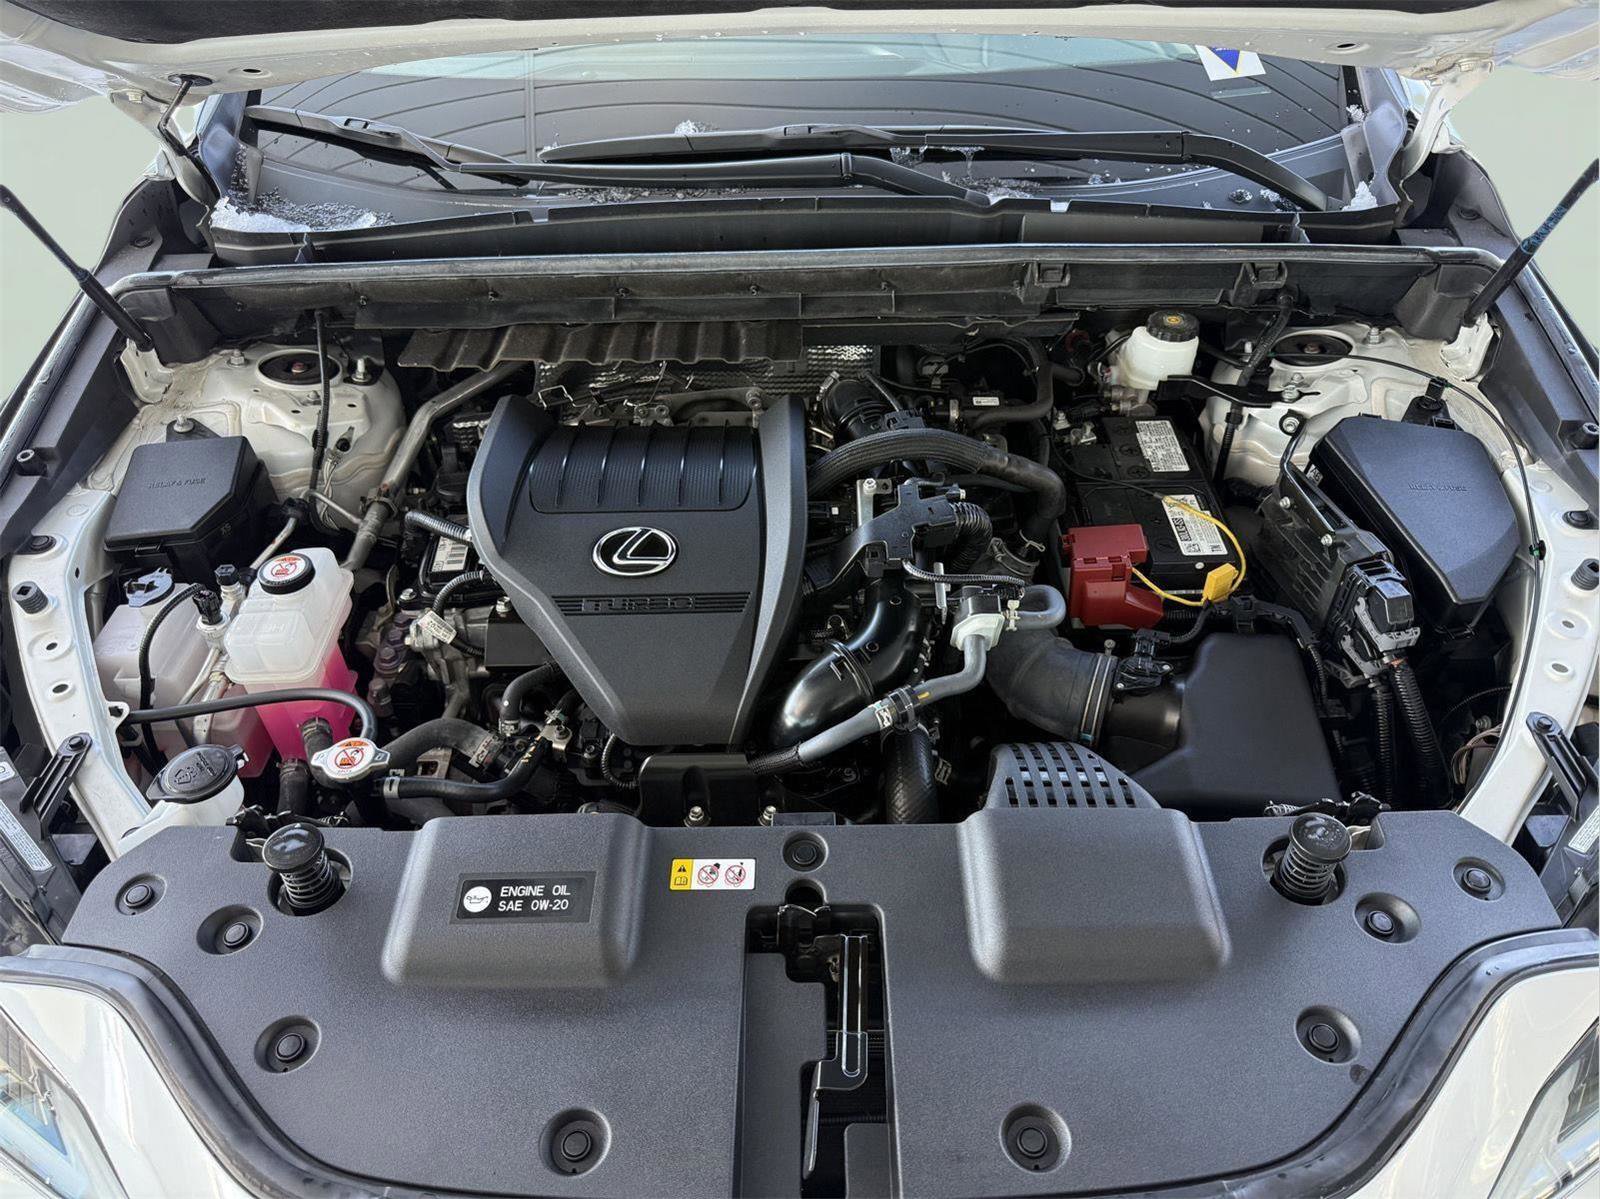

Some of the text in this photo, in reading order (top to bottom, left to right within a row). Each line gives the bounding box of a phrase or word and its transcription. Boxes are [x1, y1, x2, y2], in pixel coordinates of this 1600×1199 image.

[500, 884, 571, 897] ENGINE OIL
[498, 899, 569, 911] SAE 0W-20
